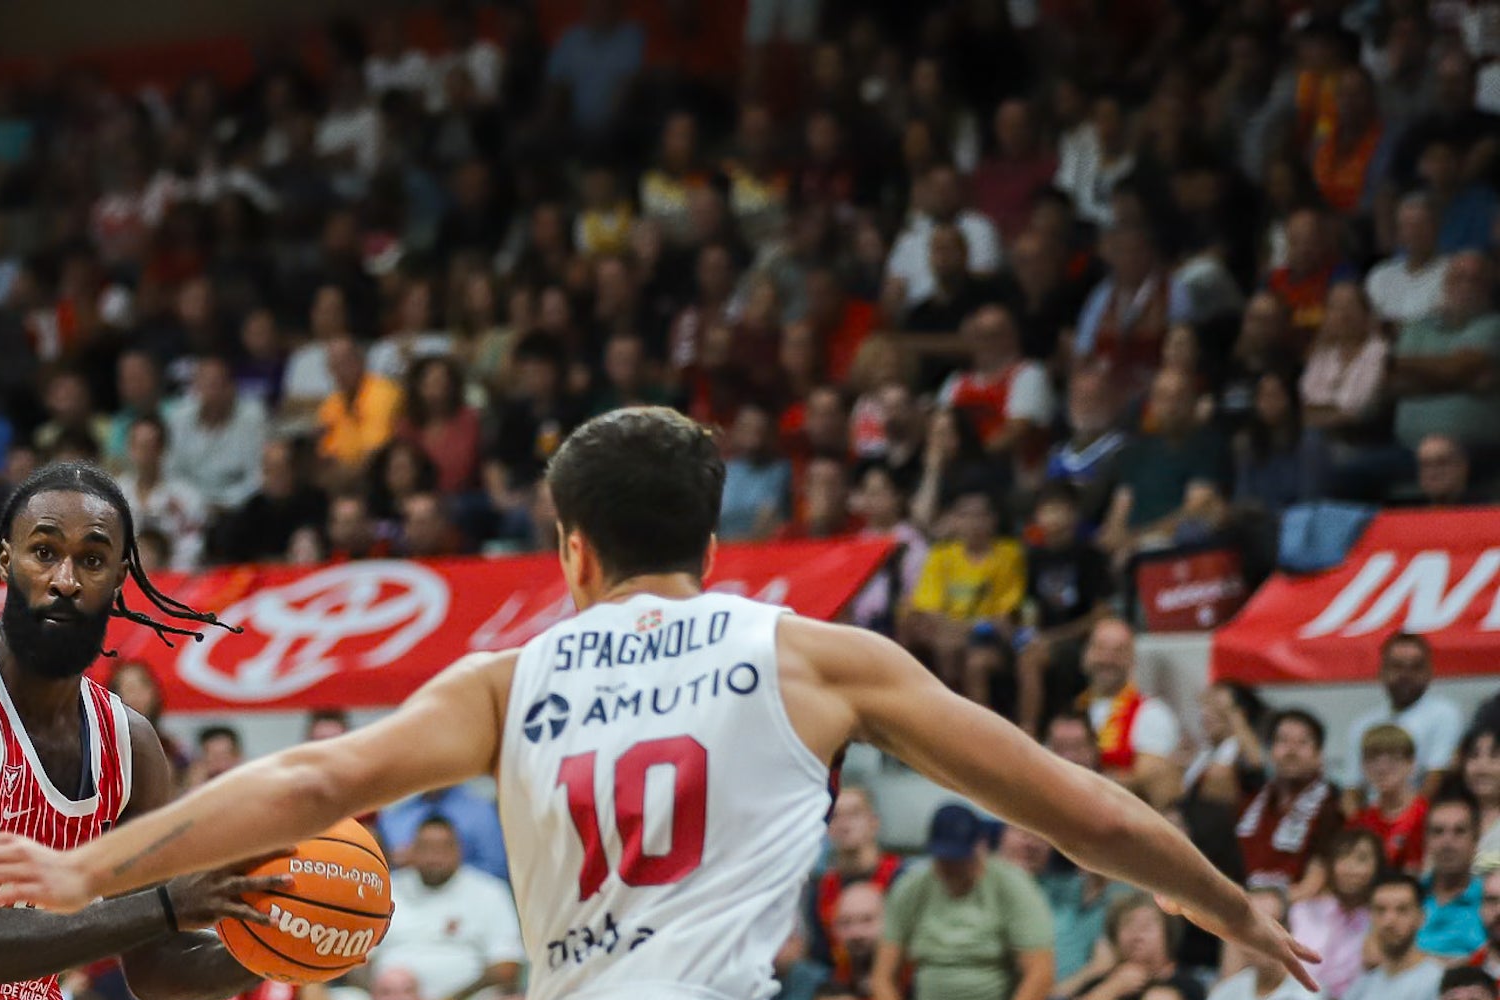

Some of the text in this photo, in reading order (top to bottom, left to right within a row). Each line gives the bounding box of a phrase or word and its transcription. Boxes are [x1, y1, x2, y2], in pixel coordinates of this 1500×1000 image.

[1298, 550, 1500, 639] IN
[554, 610, 731, 672] SPAGNOLO
[581, 661, 759, 726] AMUTIO
[556, 734, 708, 903] 10
[269, 903, 375, 958] Wilson
